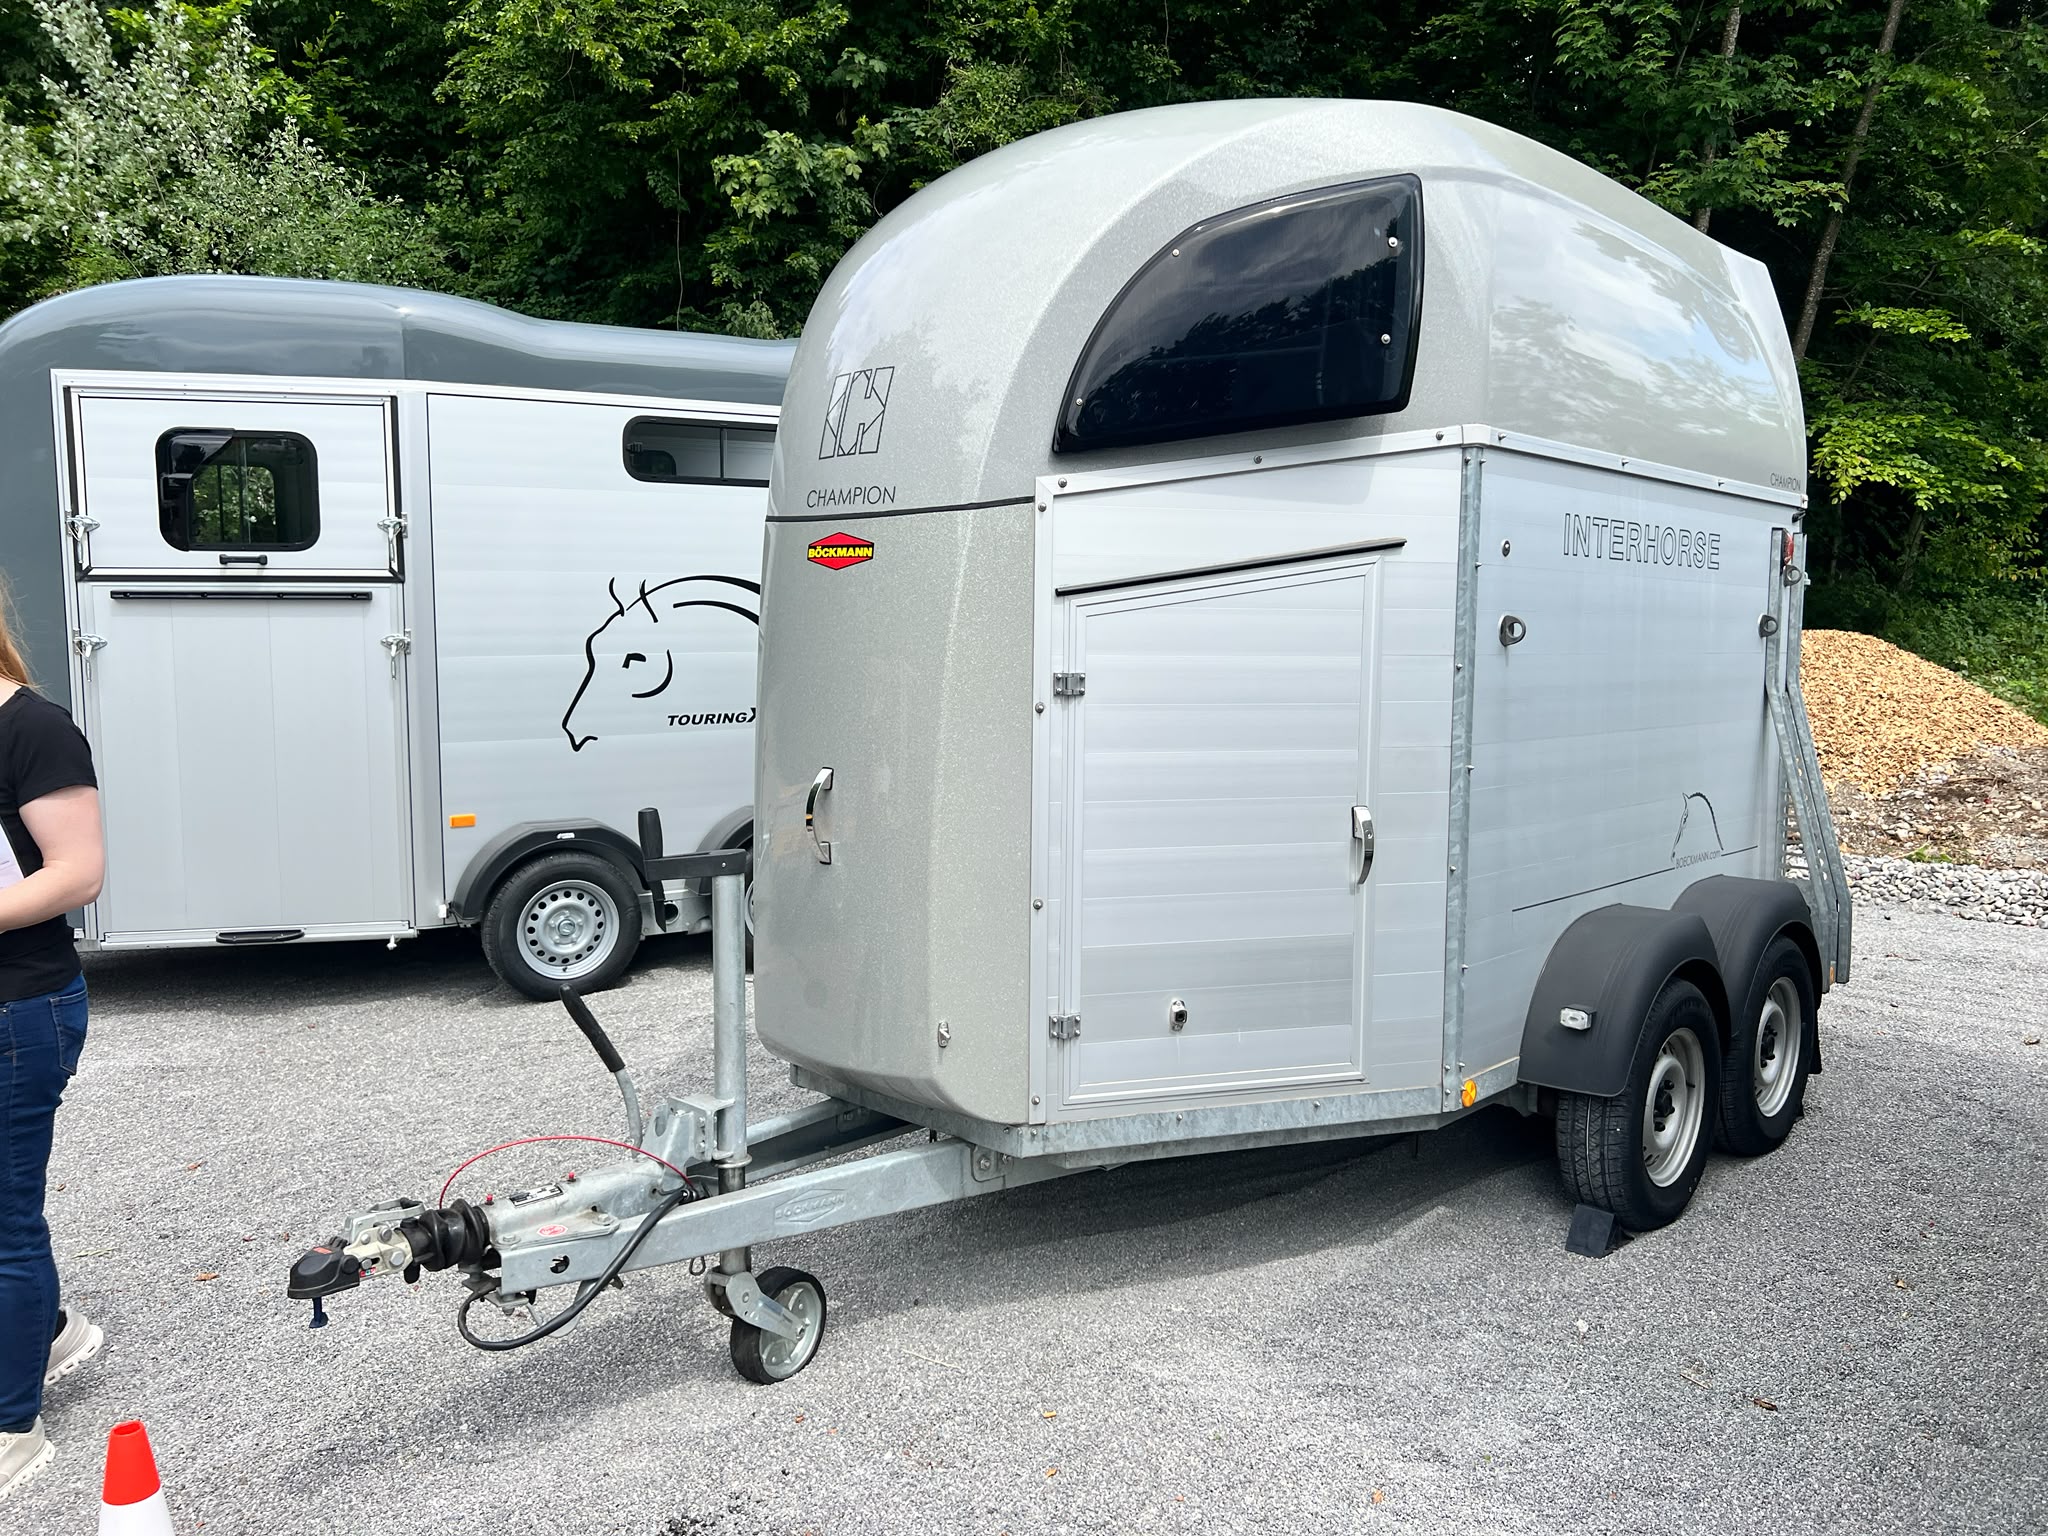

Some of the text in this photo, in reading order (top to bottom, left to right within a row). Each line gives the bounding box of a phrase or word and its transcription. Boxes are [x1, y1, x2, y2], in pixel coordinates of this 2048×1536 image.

[806, 485, 896, 508] CHAMPION
[808, 545, 873, 558] BÖCKMANN
[1562, 512, 1721, 570] INTERHORSE
